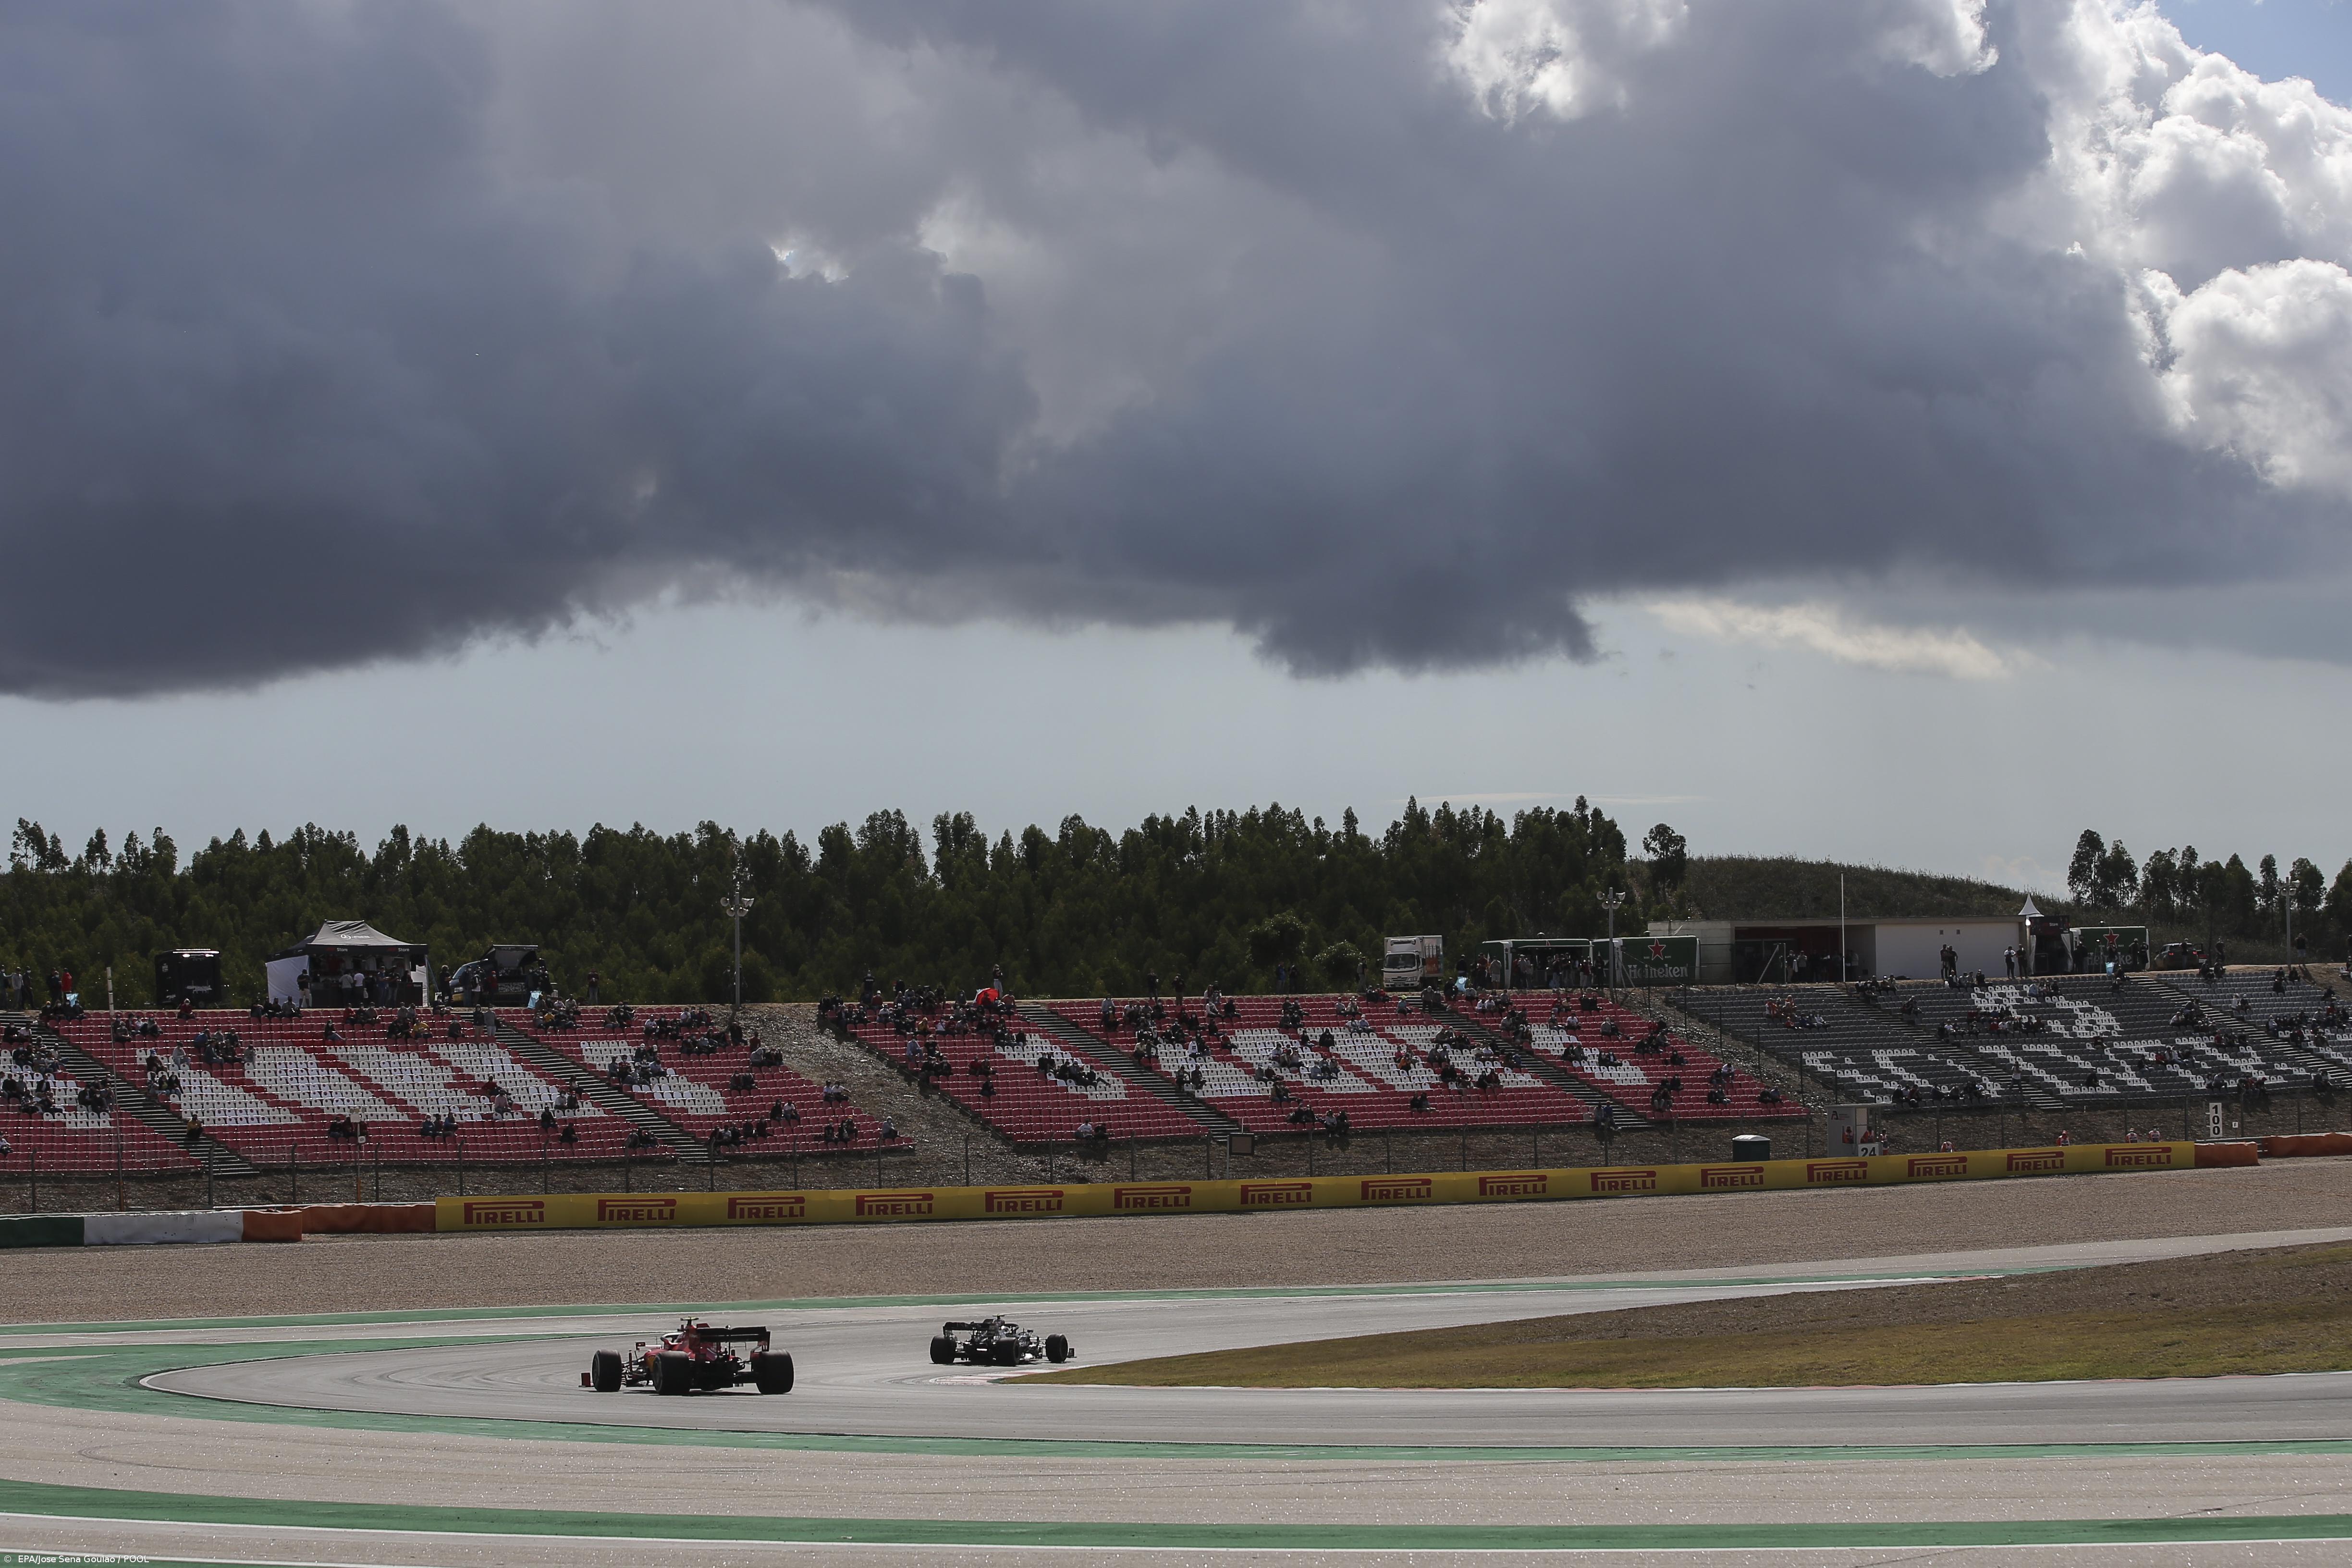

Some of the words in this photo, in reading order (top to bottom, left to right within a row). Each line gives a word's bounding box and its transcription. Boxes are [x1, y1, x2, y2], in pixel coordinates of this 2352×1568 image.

[1628, 964, 1688, 979] Heineken
[2212, 1104, 2220, 1135] 100
[1861, 1147, 1877, 1157] 24
[2007, 1151, 2064, 1171] PIRELLI
[2105, 1146, 2171, 1166] PIRELLI
[1701, 1166, 1764, 1187] PIRELLI
[1807, 1161, 1868, 1182] PIRELLI
[1908, 1156, 1967, 1177] PIRELLI
[1361, 1178, 1432, 1200] PIRELLI
[1479, 1175, 1547, 1196] PIRELLI
[1591, 1171, 1656, 1191] PIRELLI
[985, 1190, 1064, 1213] PIRELLI
[1114, 1186, 1192, 1209] PIRELLI
[1240, 1182, 1312, 1205] PIRELLI
[464, 1200, 545, 1225] PIRELLI
[598, 1199, 677, 1222] PIRELLI
[728, 1196, 805, 1219] PIRELLI
[856, 1193, 934, 1216] PIRELLI
